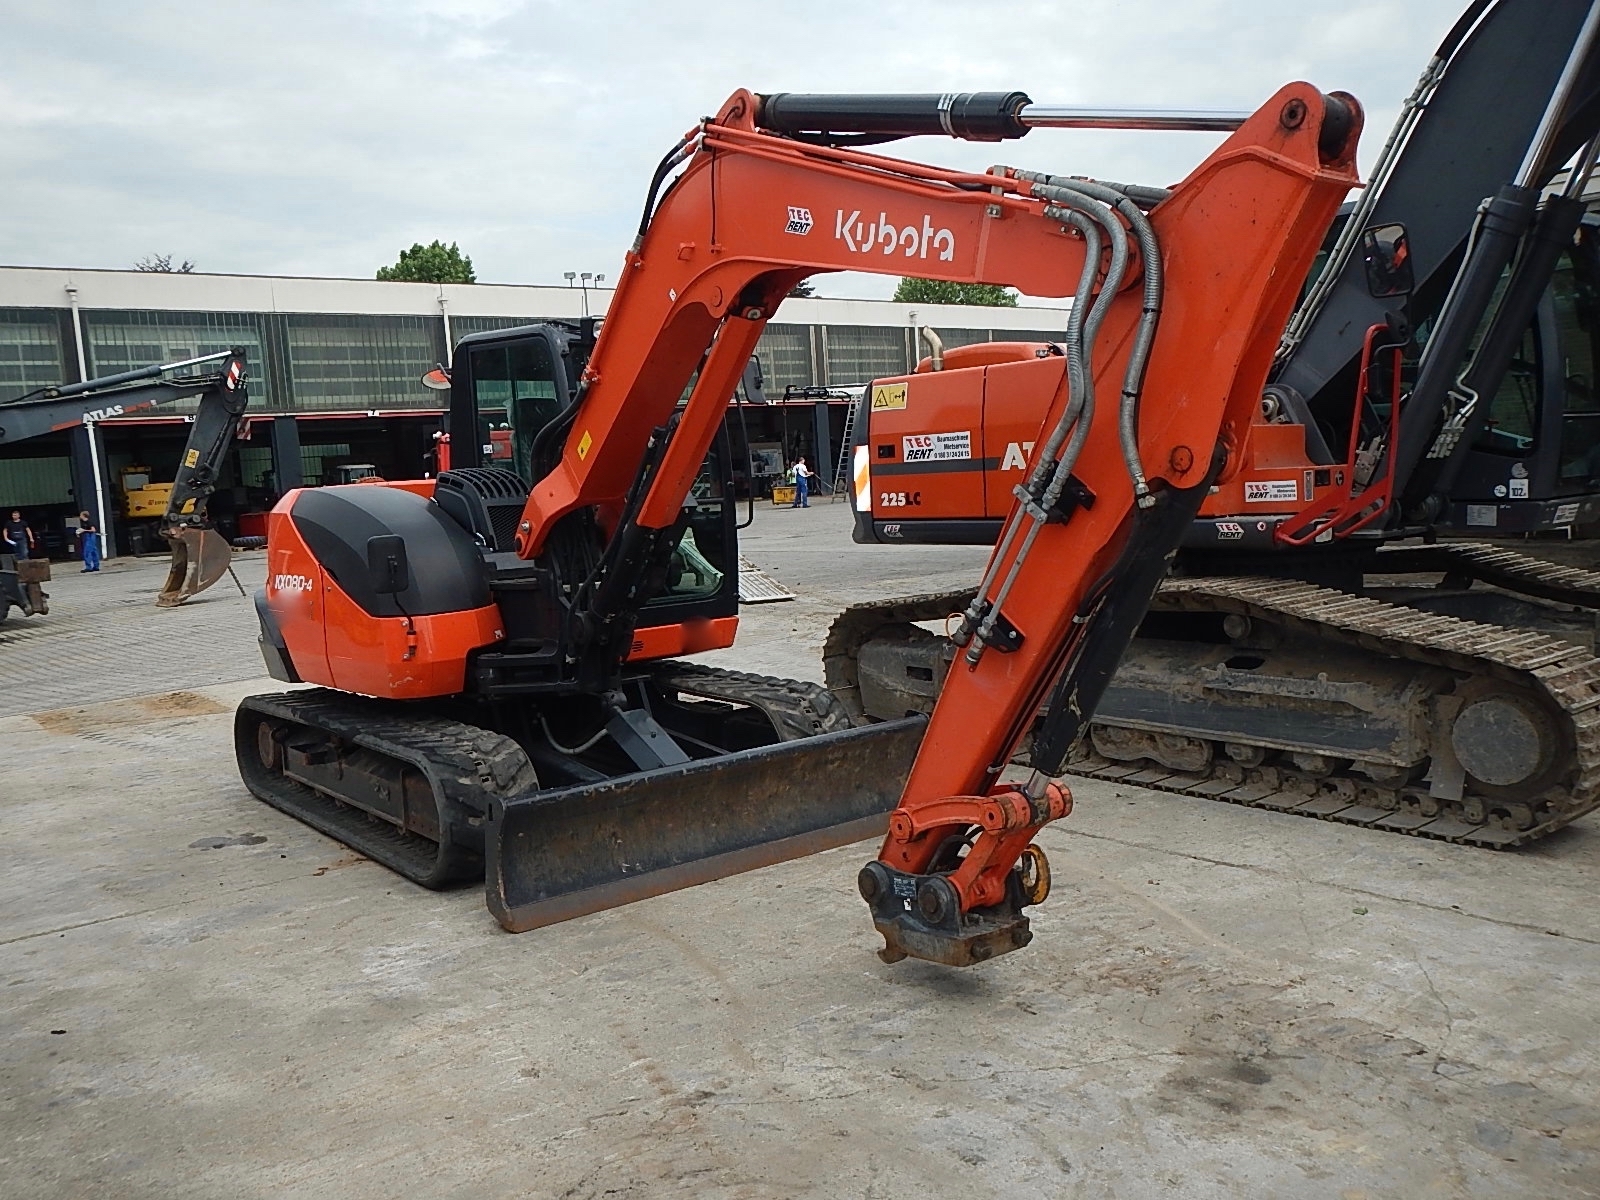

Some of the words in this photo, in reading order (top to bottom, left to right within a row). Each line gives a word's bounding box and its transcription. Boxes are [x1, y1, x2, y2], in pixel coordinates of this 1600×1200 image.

[789, 209, 810, 221] TEC
[787, 221, 811, 233] RENT
[835, 209, 955, 262] Kubota
[82, 404, 124, 424] ATLAS
[905, 436, 932, 449] TEC
[906, 449, 934, 460] RENT
[1247, 484, 1268, 492] TEC
[1248, 491, 1269, 499] RENT
[1218, 524, 1239, 532] TEC
[1219, 531, 1242, 539] RENT
[274, 574, 313, 592] KX080-4
